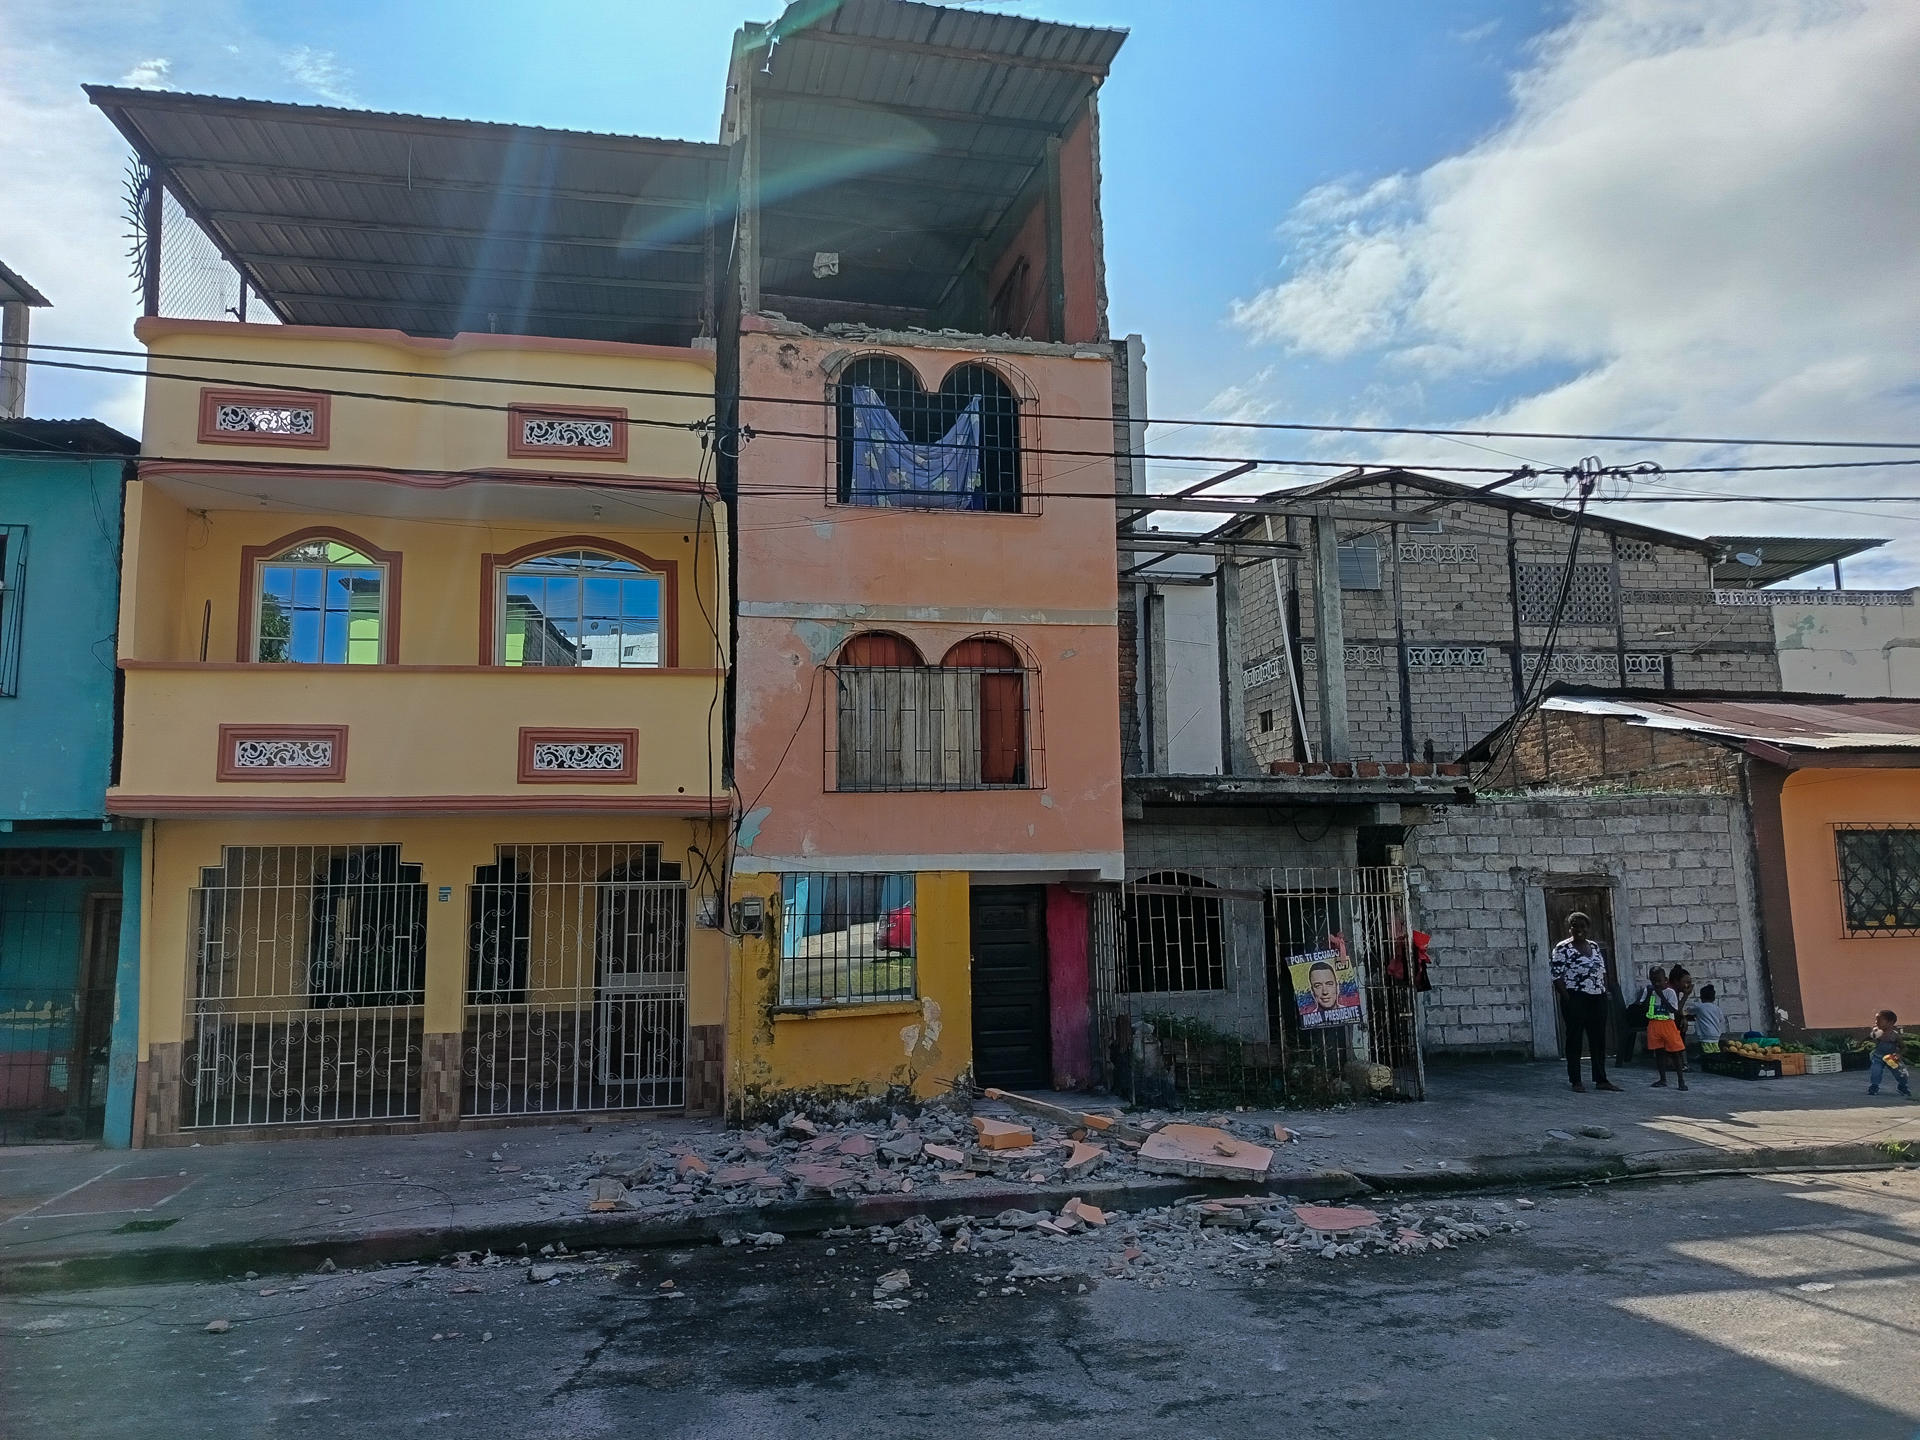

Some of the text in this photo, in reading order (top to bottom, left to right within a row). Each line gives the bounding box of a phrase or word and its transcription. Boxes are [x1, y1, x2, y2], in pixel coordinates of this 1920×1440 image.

[1290, 949, 1341, 965] POR TI ECUADO
[1324, 1005, 1360, 1021] PRESIDENTE
